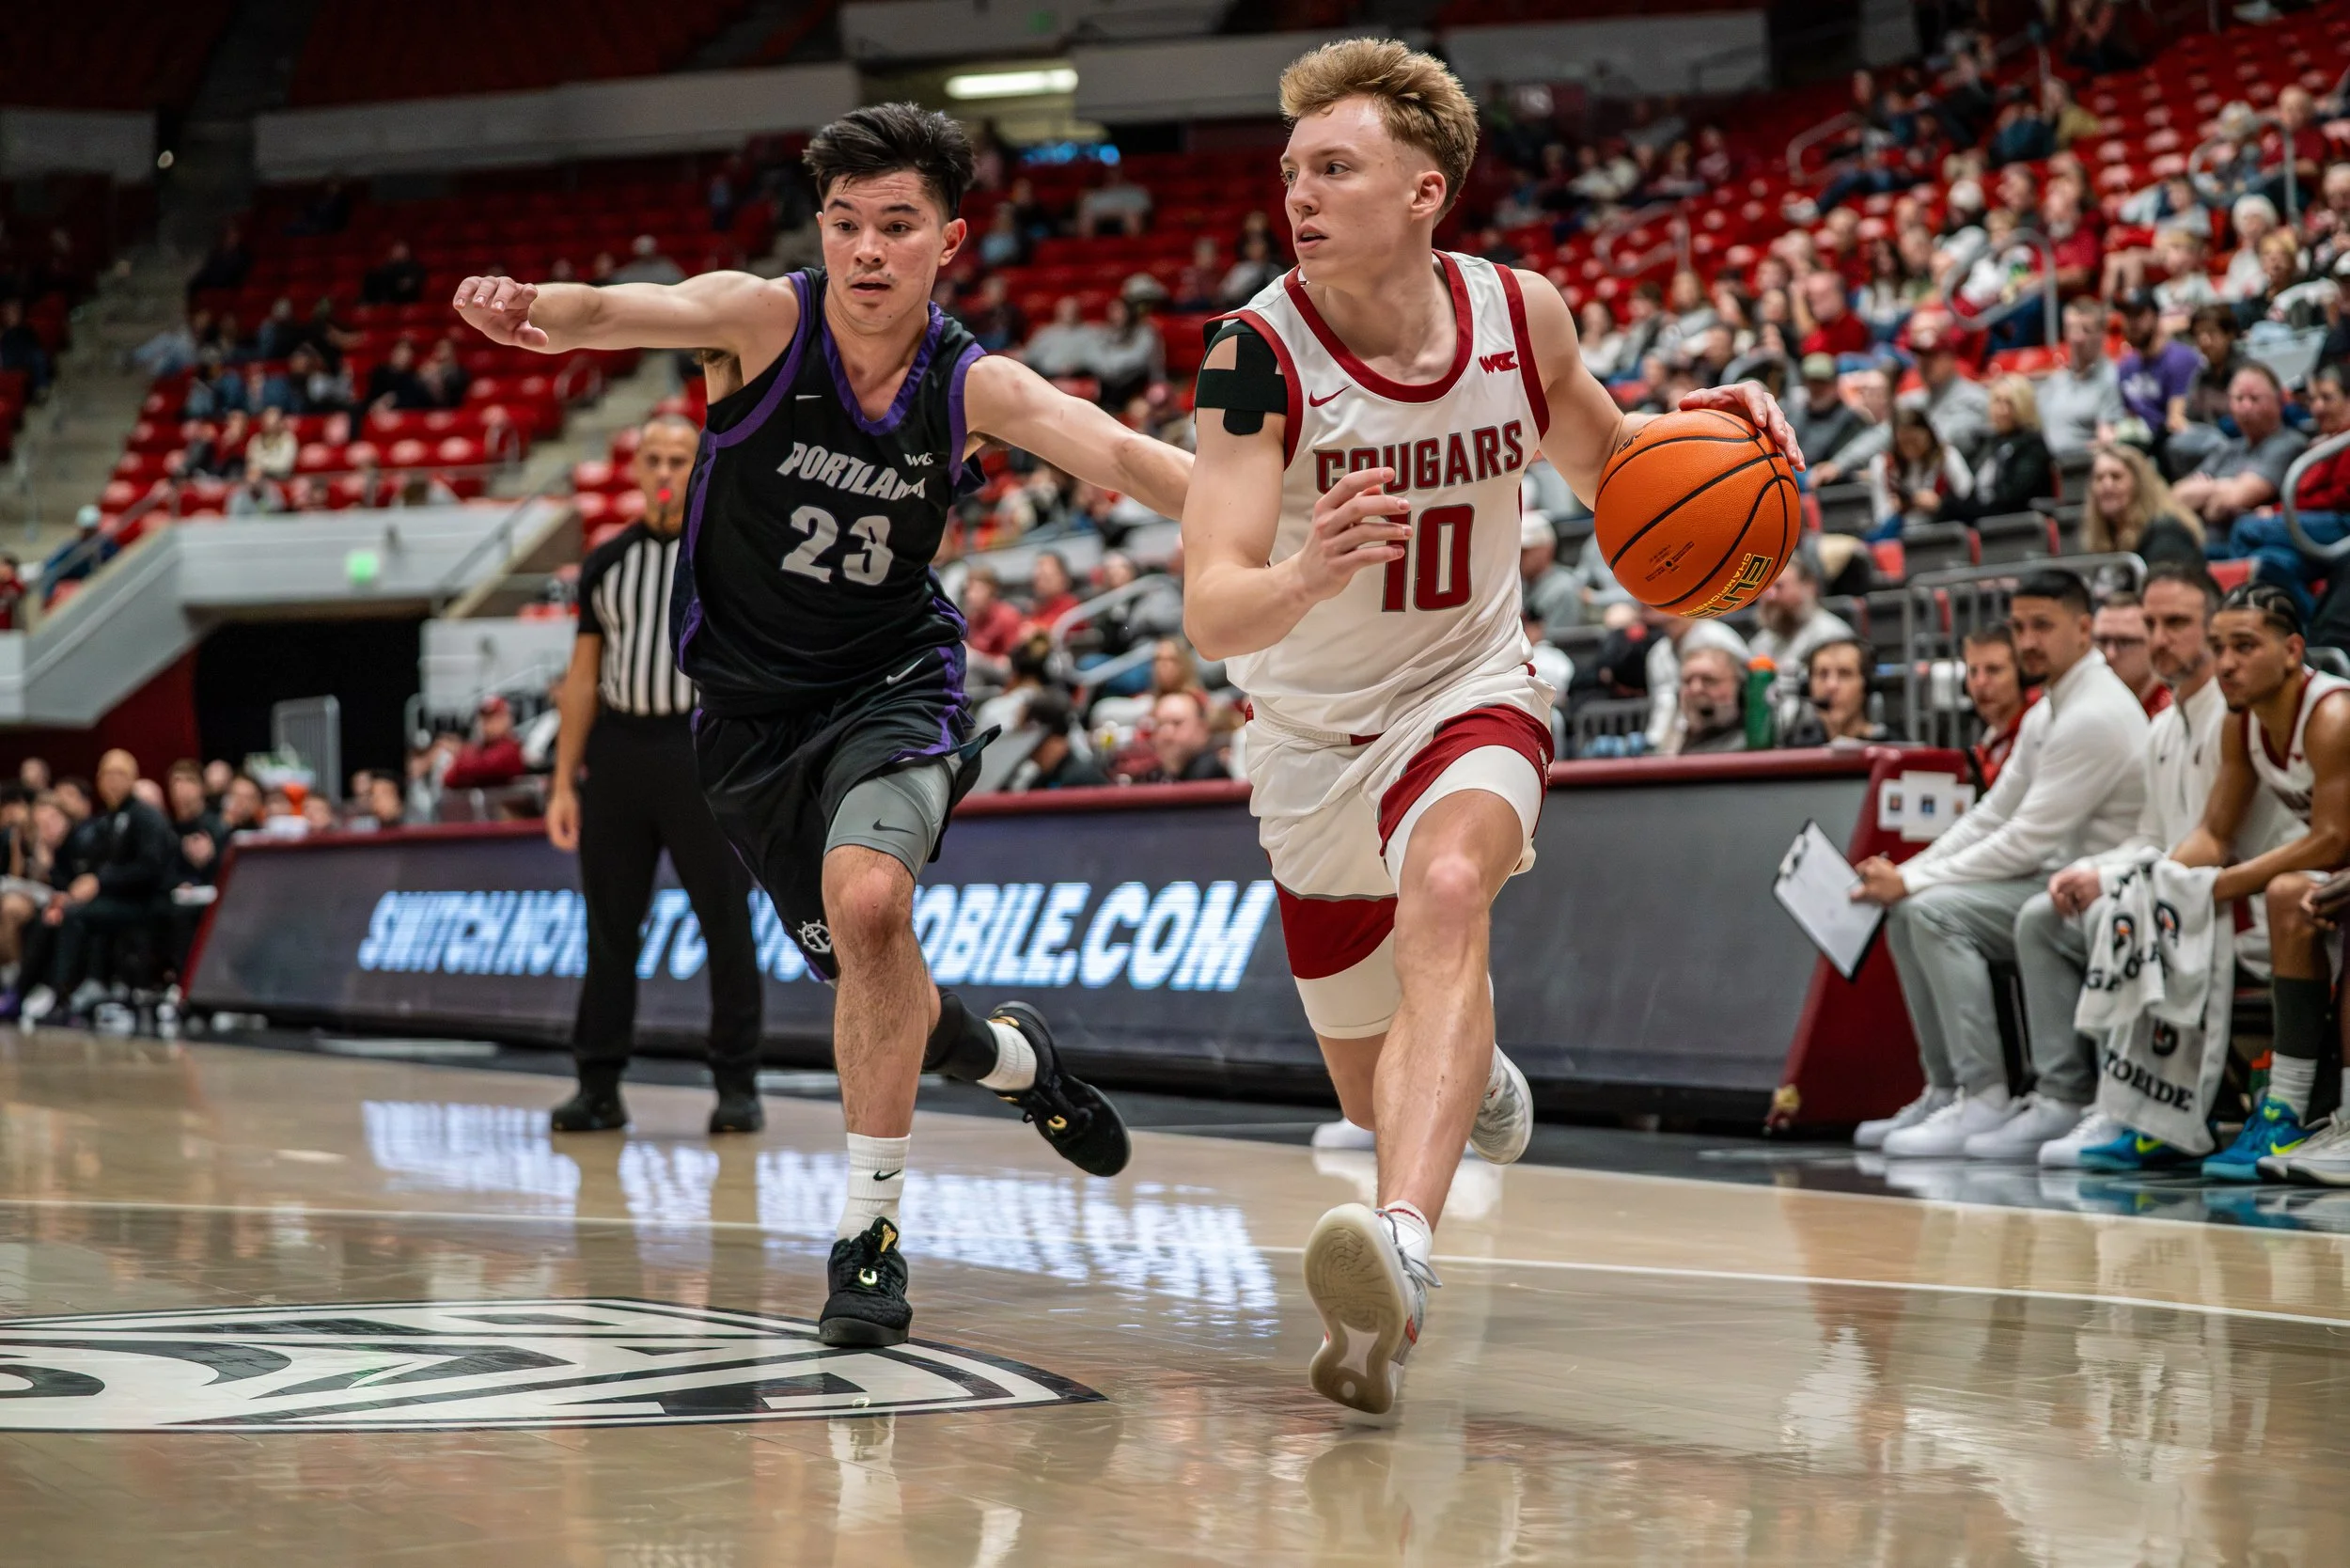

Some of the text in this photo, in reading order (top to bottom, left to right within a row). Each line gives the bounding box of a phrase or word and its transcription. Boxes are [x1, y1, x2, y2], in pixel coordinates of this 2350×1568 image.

[781, 505, 894, 587] 23
[1378, 504, 1475, 613] 10
[912, 880, 1277, 992] OBILE.COM
